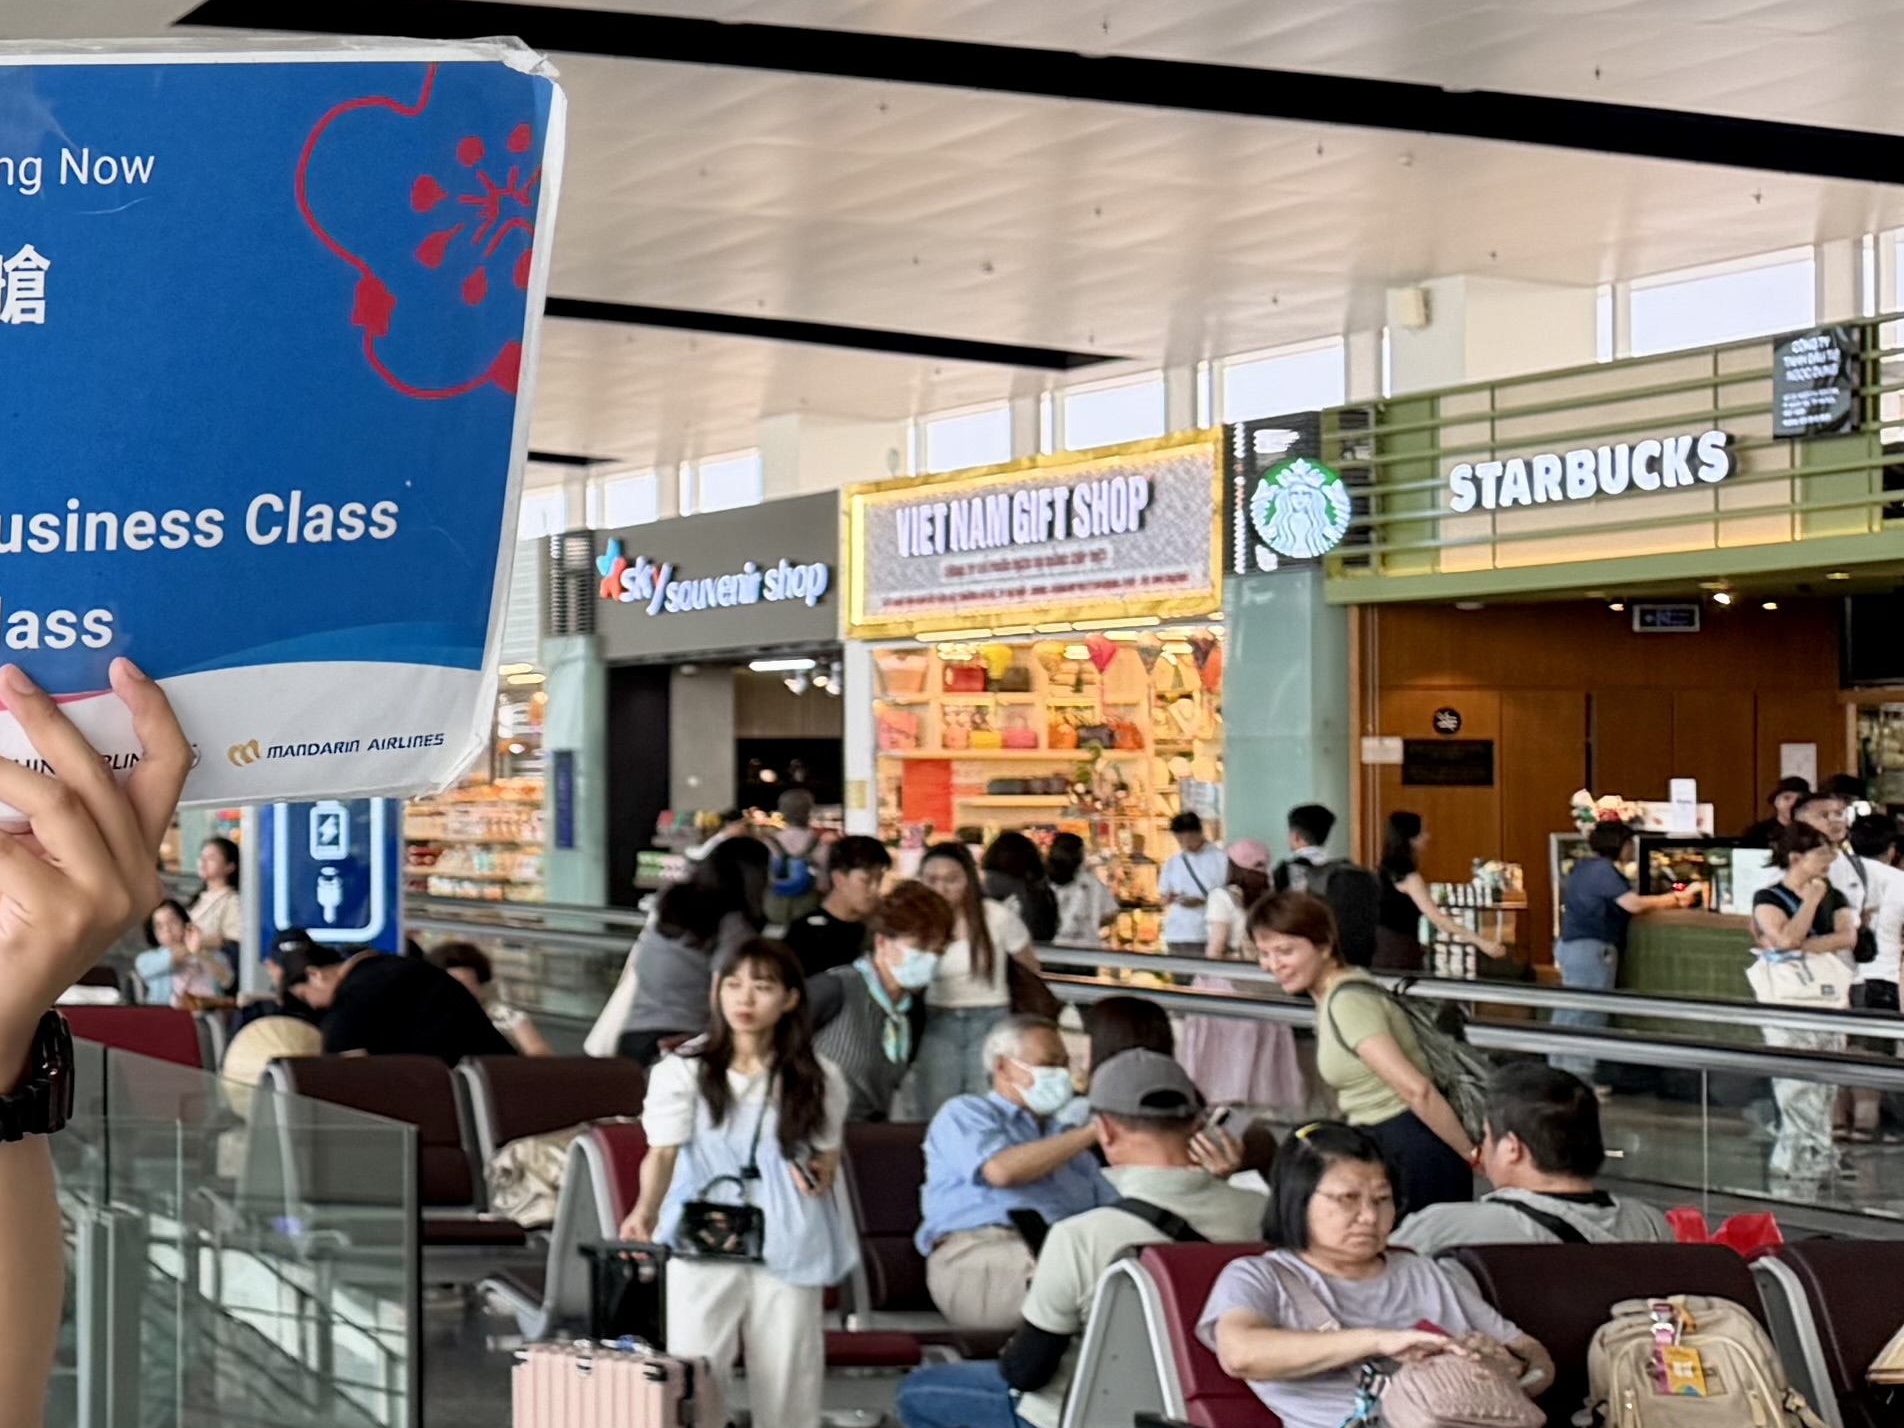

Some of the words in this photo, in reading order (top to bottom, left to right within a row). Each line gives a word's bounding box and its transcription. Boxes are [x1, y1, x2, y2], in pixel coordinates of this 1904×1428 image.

[60, 147, 156, 185] Now
[1449, 430, 1730, 513] STARBUCKS
[244, 489, 400, 546] Class
[896, 503, 948, 558] VIET
[949, 493, 1010, 552] NAM
[1013, 486, 1070, 545] GIFT
[1071, 475, 1149, 539] SHOP
[619, 555, 674, 616] sky
[664, 559, 762, 613] souvenir
[763, 558, 829, 607] shop
[266, 739, 361, 759] MANDARIN
[367, 733, 445, 751] AIRLINES
